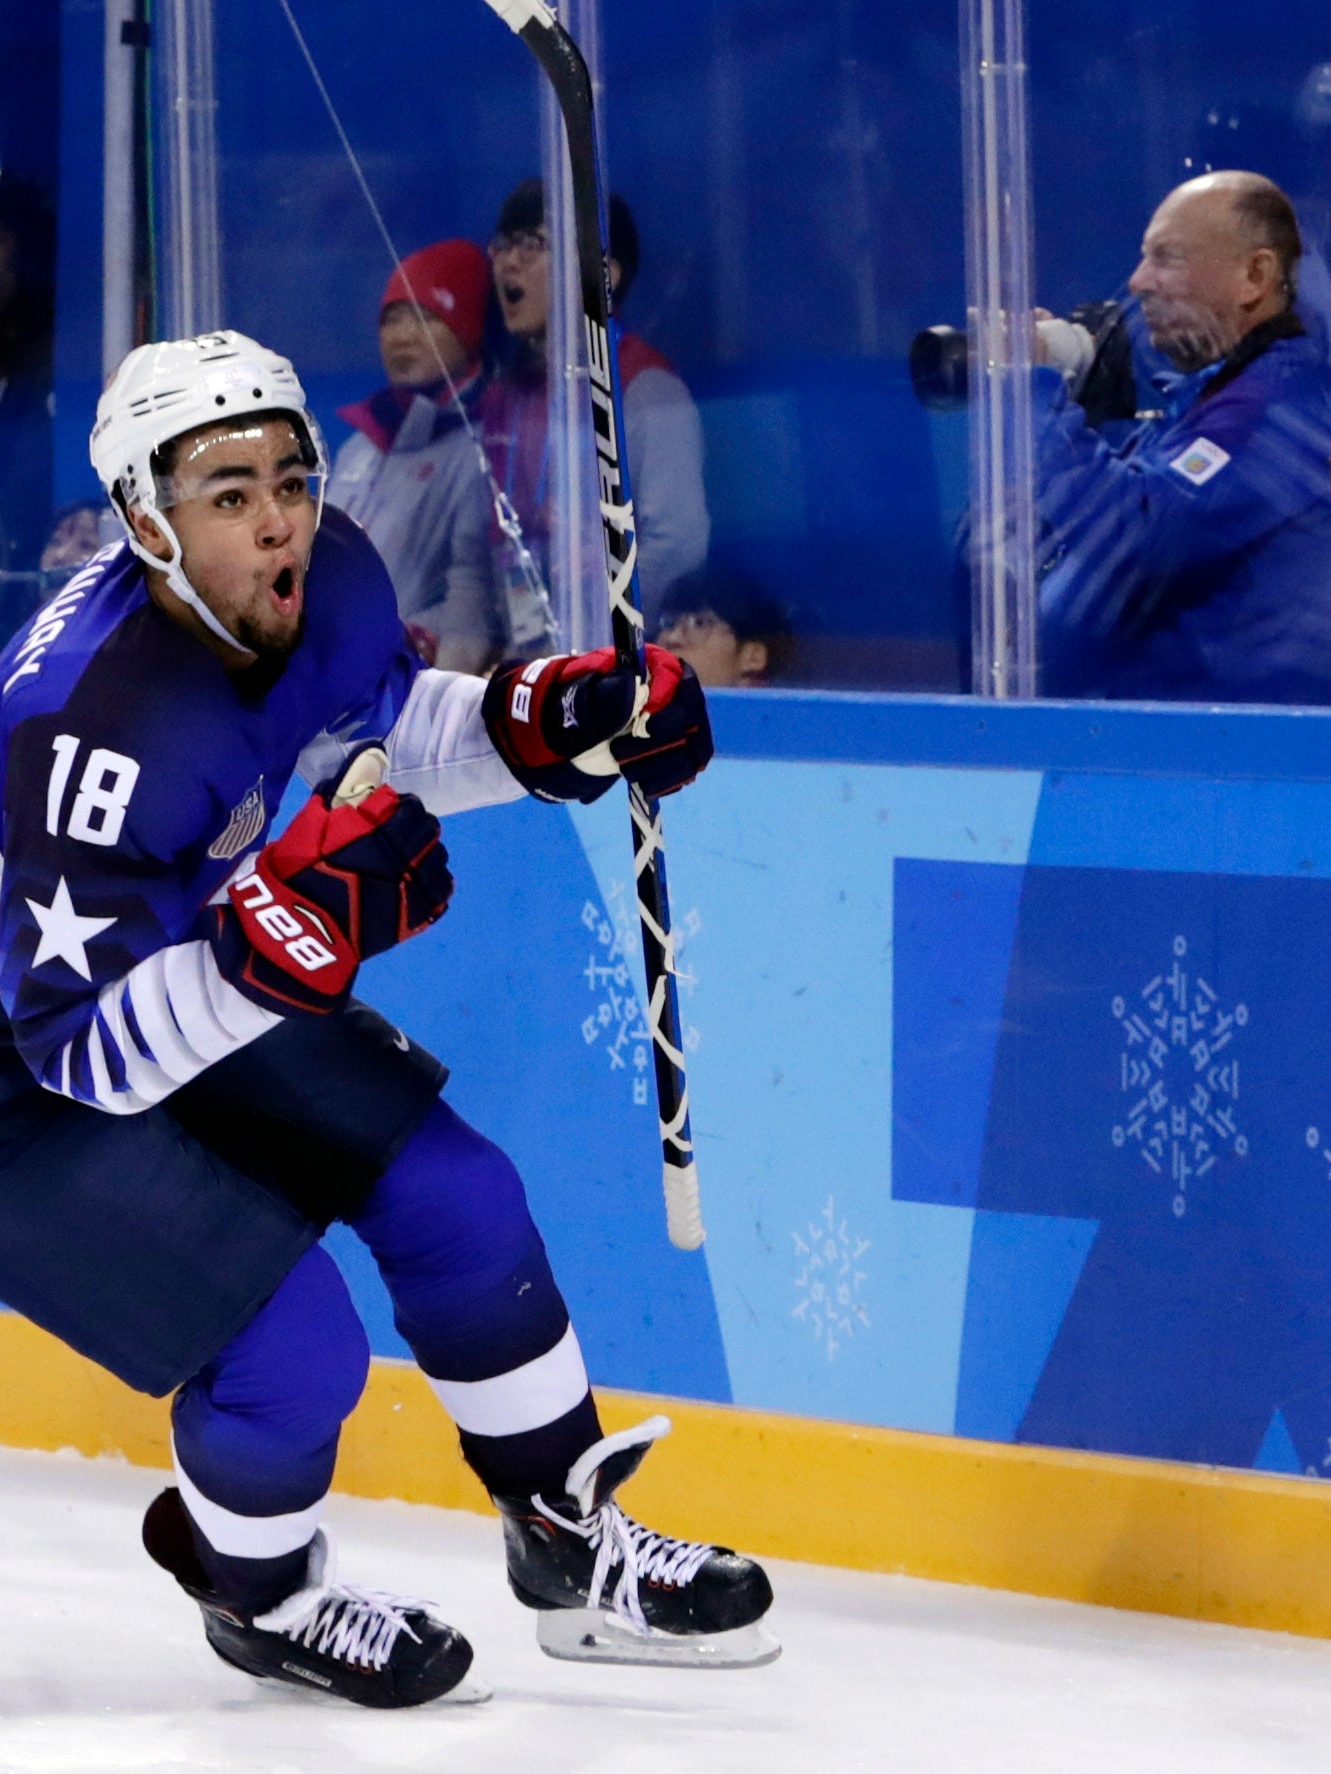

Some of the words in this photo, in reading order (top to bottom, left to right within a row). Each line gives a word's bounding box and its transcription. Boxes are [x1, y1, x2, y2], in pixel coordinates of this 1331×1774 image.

[511, 655, 570, 723] BA
[47, 734, 140, 846] 18
[234, 791, 259, 820] USA
